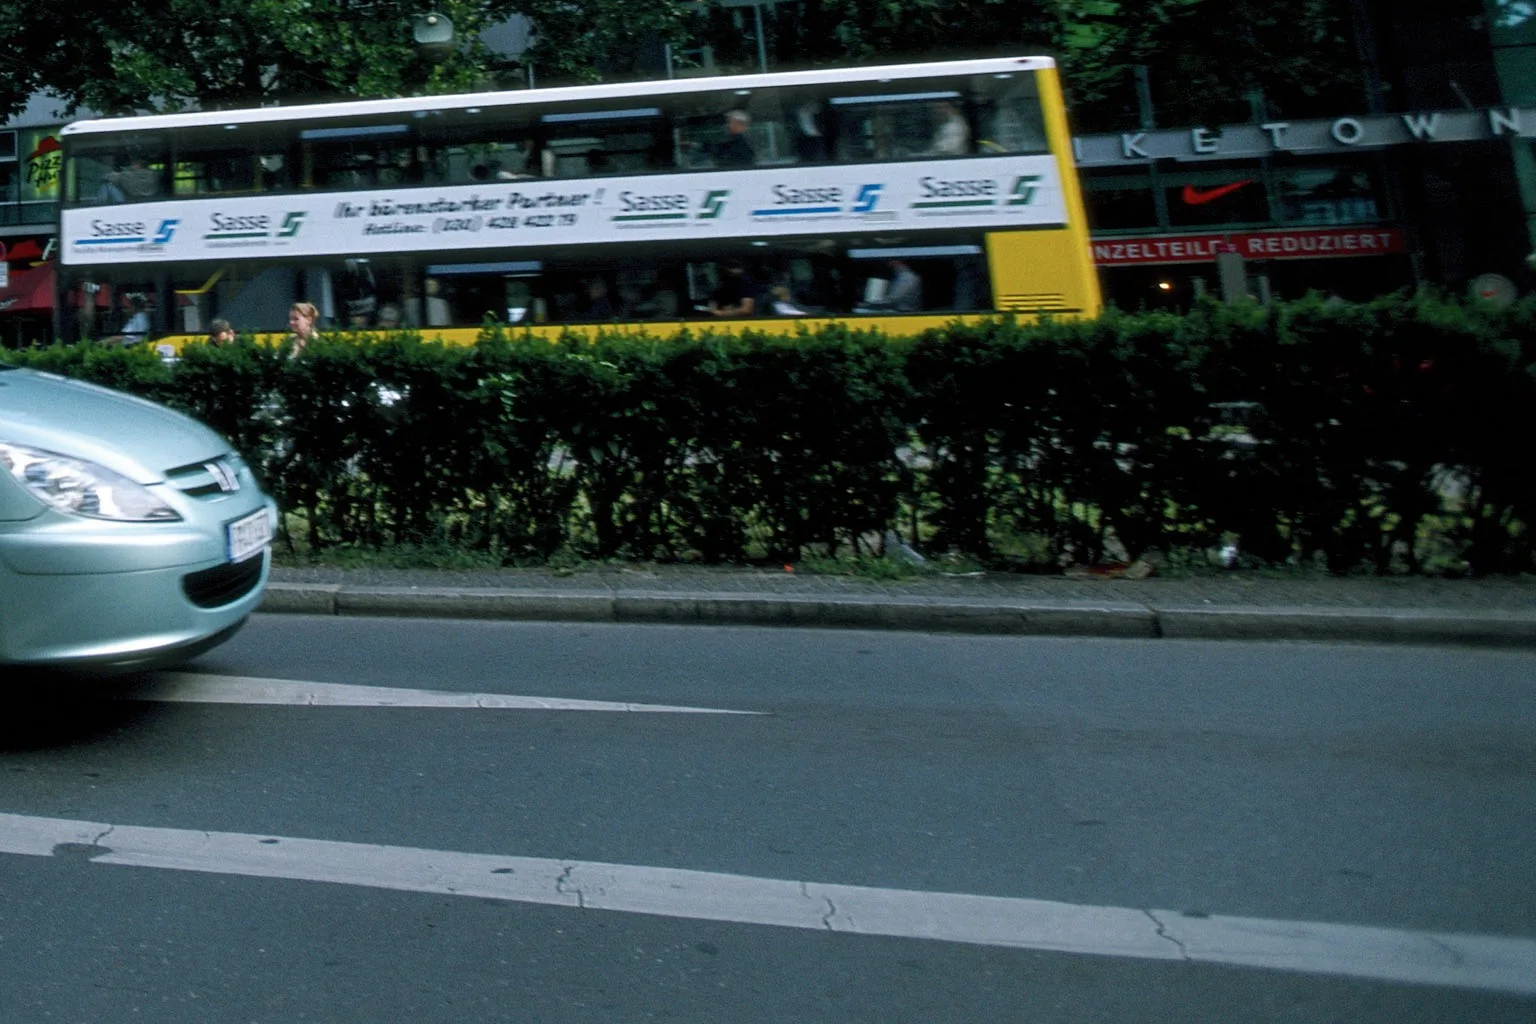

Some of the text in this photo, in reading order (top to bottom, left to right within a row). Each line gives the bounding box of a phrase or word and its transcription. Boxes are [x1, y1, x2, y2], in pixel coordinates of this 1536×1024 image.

[1075, 107, 1521, 162] IKETOWN
[771, 183, 844, 206] Sasse
[919, 175, 999, 199] Sasse
[619, 190, 689, 213] Sasse
[91, 219, 146, 238] Sasse
[210, 211, 271, 232] Sasse
[1247, 232, 1392, 254] REDUZIERT
